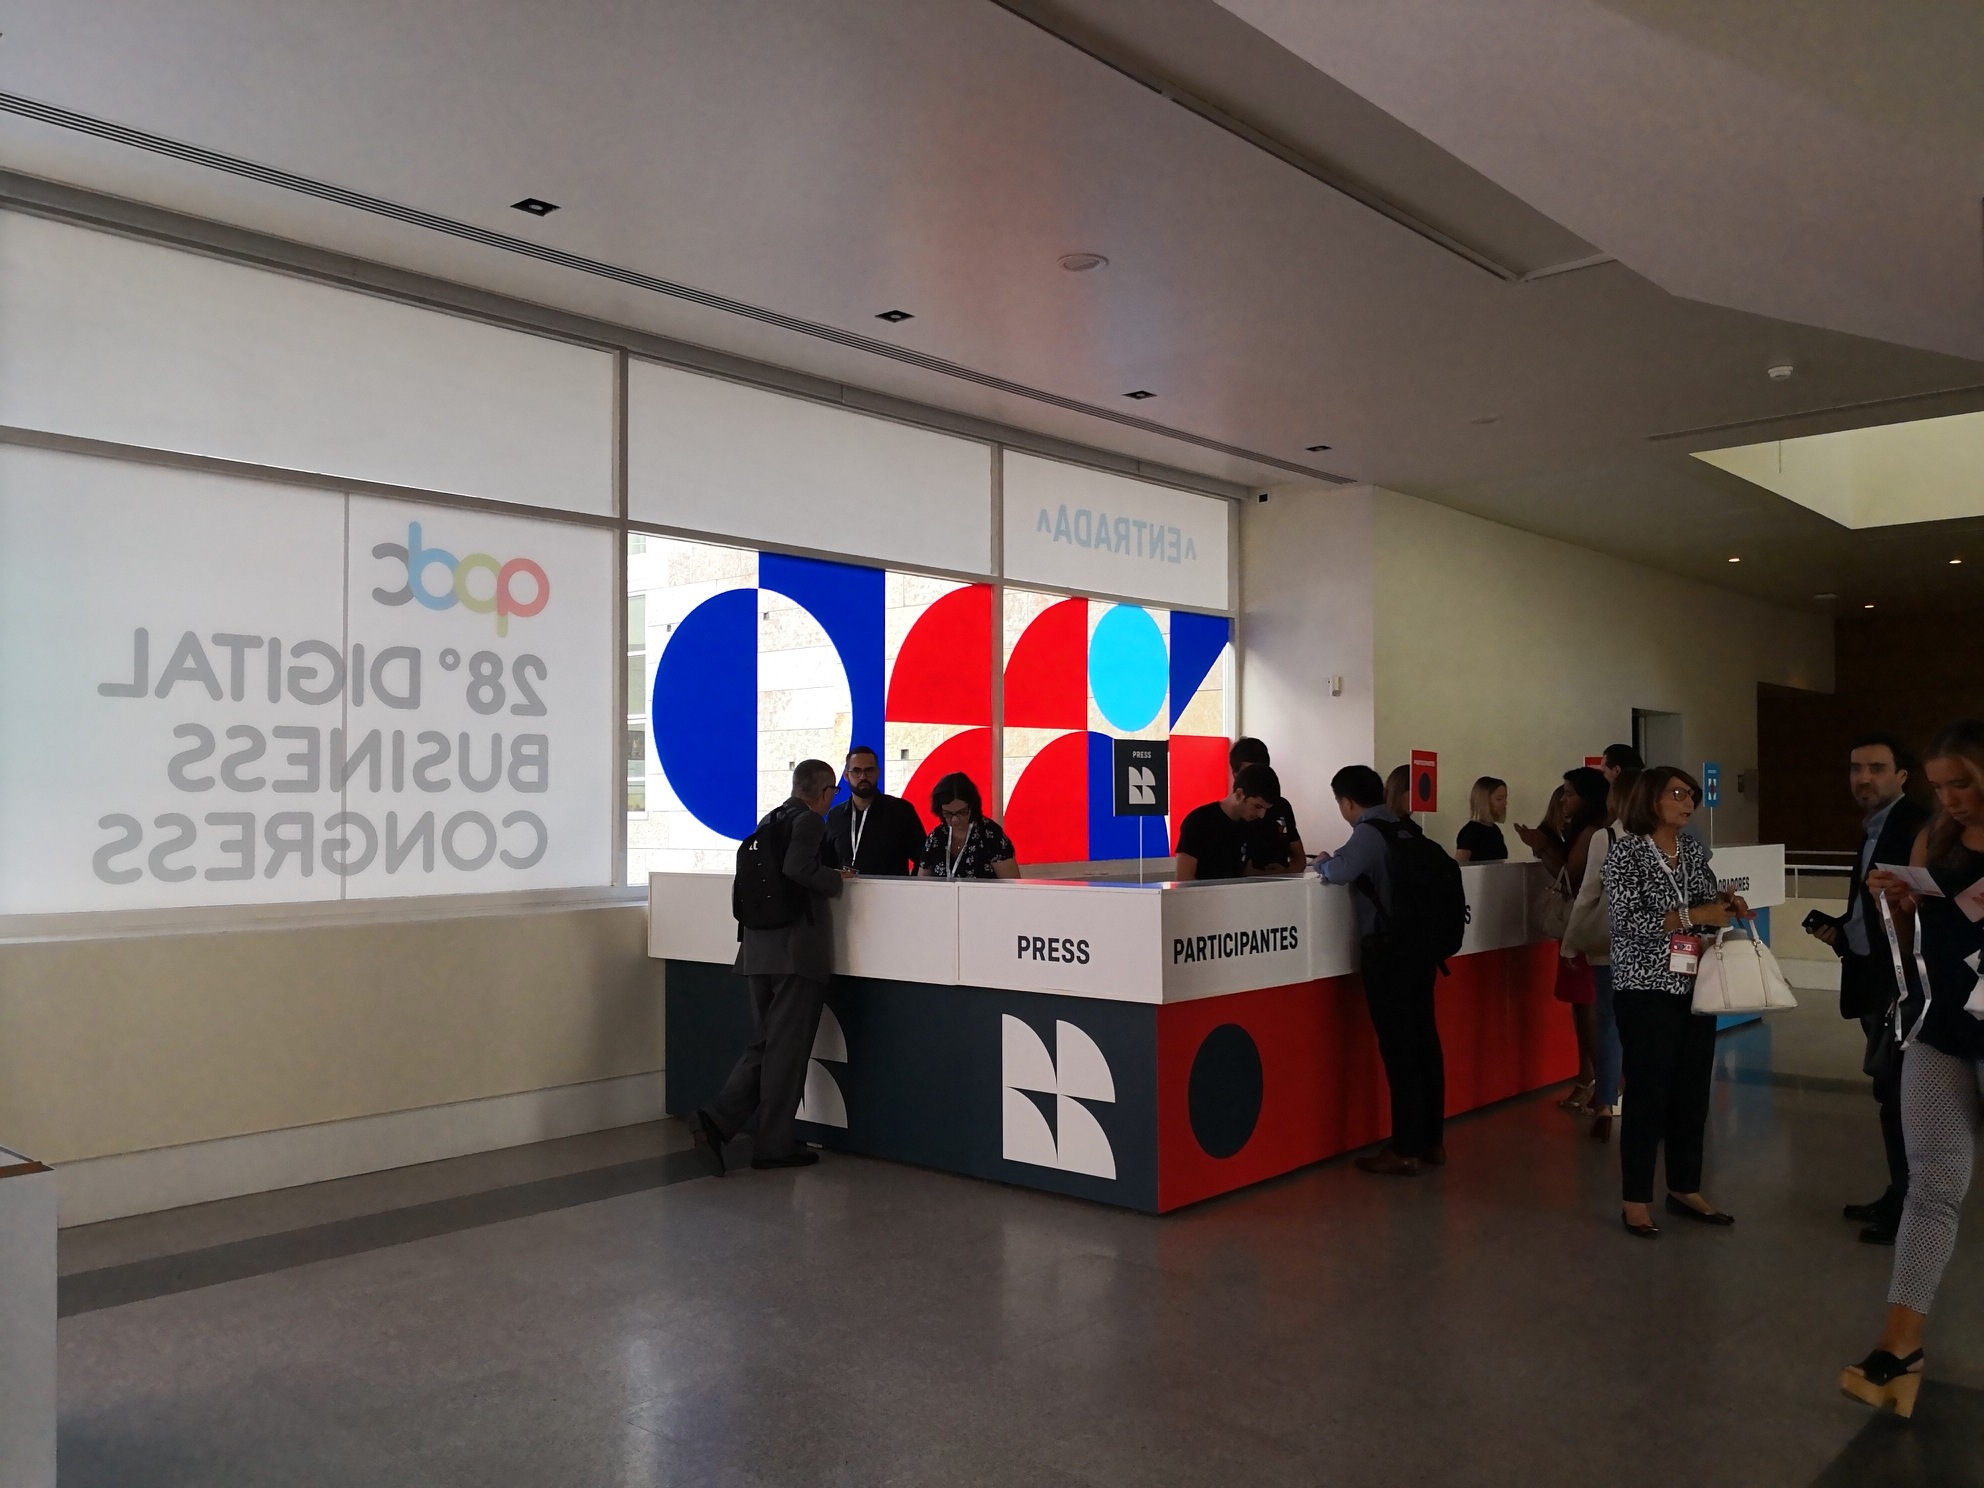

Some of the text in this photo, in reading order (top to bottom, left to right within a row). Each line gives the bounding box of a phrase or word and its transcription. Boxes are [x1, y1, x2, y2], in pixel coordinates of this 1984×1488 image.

[1132, 750, 1152, 759] PRESS
[1017, 935, 1090, 965] PRESS
[1173, 925, 1299, 965] PARTICIPANTES
